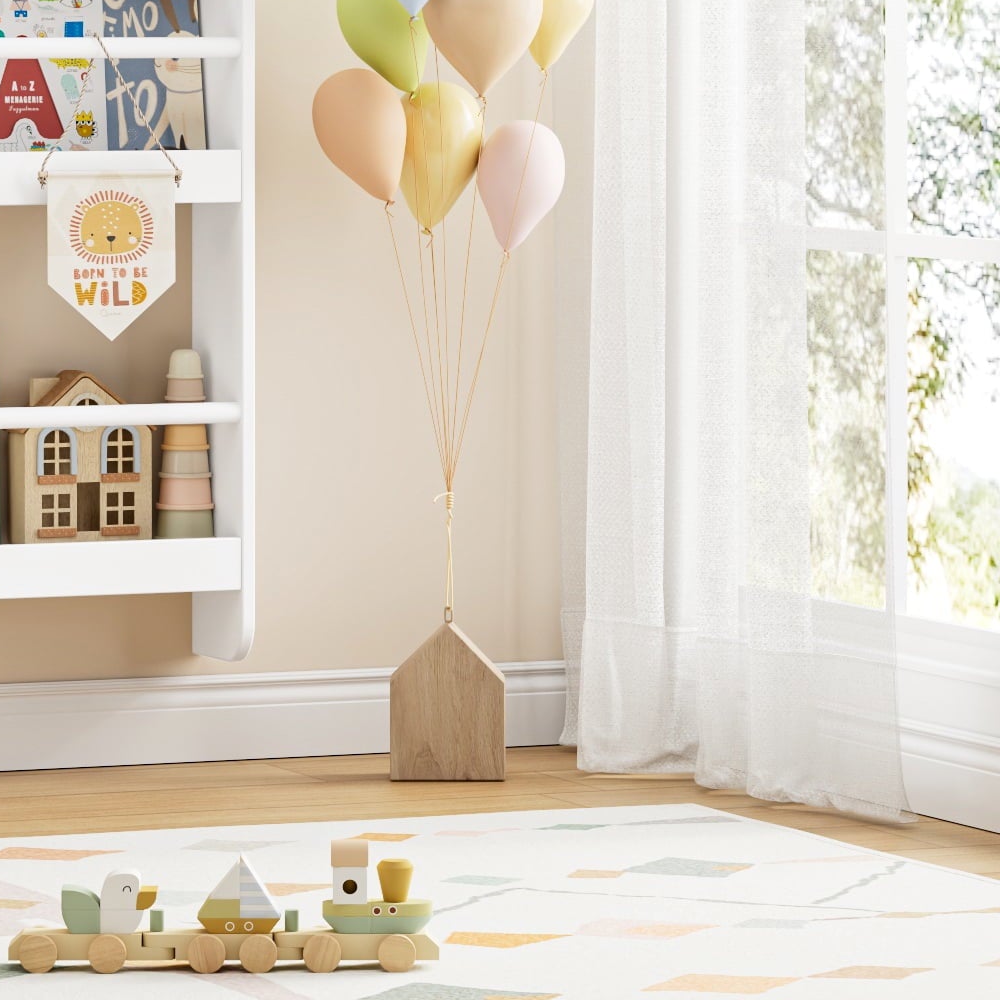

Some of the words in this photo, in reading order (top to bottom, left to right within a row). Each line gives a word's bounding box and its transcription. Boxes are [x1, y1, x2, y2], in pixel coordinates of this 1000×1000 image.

[11, 80, 18, 92] A
[29, 80, 36, 92] Z
[4, 95, 44, 104] MENAGERIE
[73, 268, 105, 280] BORN
[112, 267, 127, 278] TO
[133, 266, 148, 278] BE
